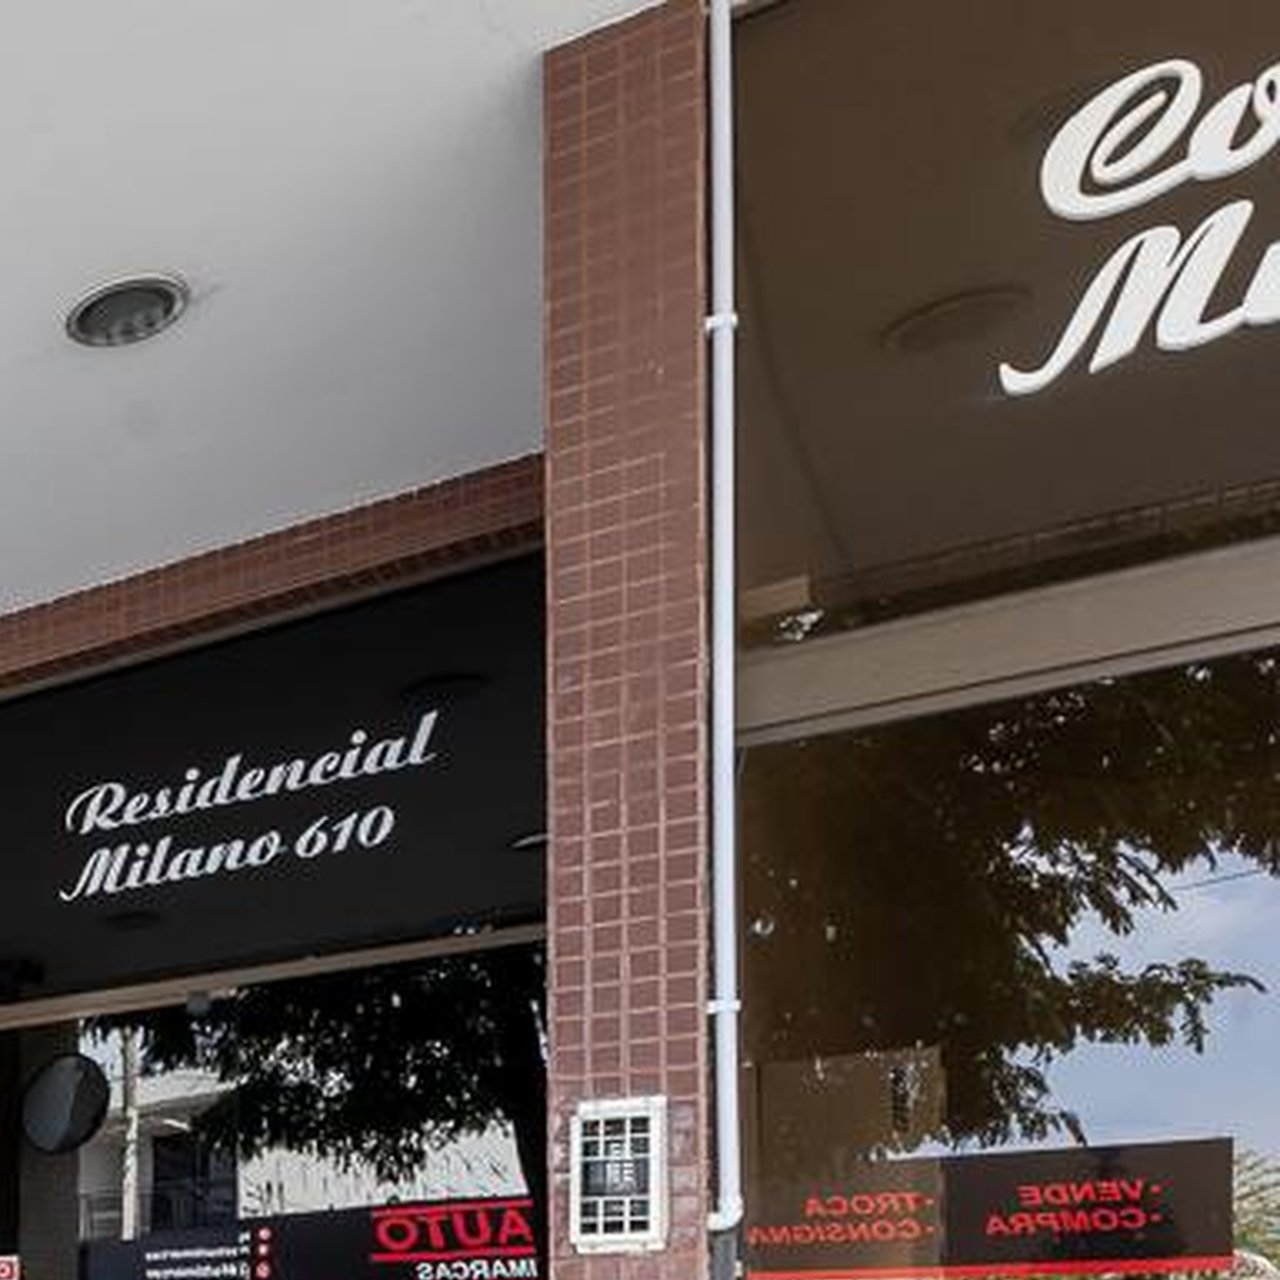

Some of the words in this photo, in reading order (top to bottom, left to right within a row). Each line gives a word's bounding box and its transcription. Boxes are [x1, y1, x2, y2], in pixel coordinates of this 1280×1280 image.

[65, 710, 438, 834] Residencial
[59, 829, 288, 901] Milano
[295, 805, 396, 858] 610
